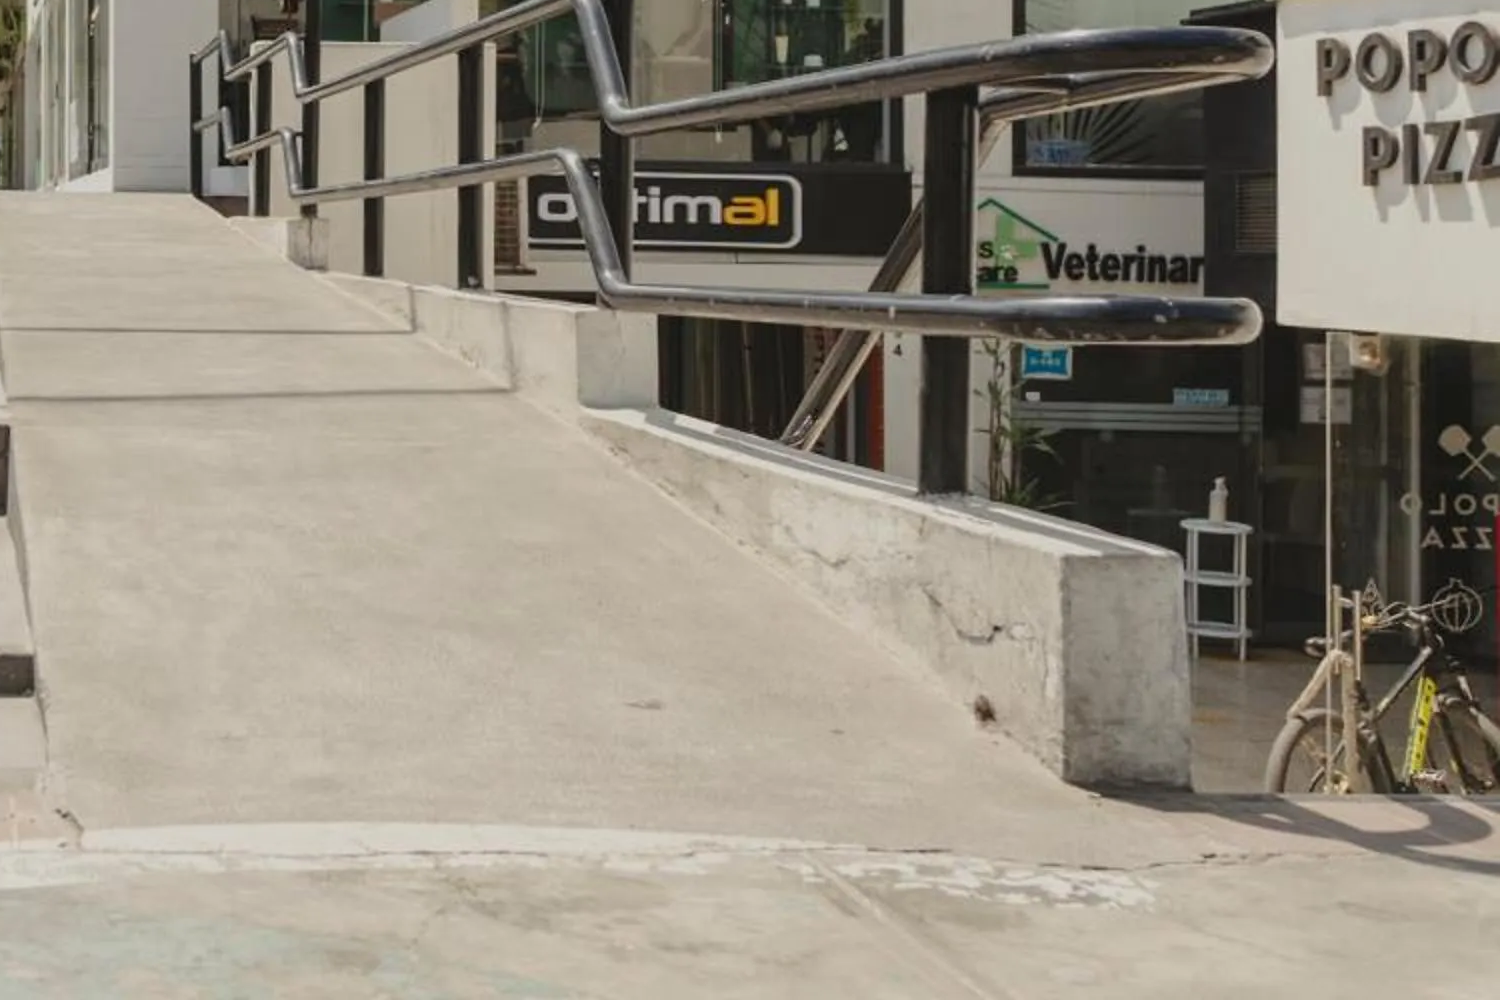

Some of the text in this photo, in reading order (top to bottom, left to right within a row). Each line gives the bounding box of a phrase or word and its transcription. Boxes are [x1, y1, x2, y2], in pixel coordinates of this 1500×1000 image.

[1316, 21, 1500, 96] POPO
[1362, 113, 1500, 186] PIZZ
[538, 187, 779, 226] otimal
[1040, 242, 1203, 283] Veterinar
